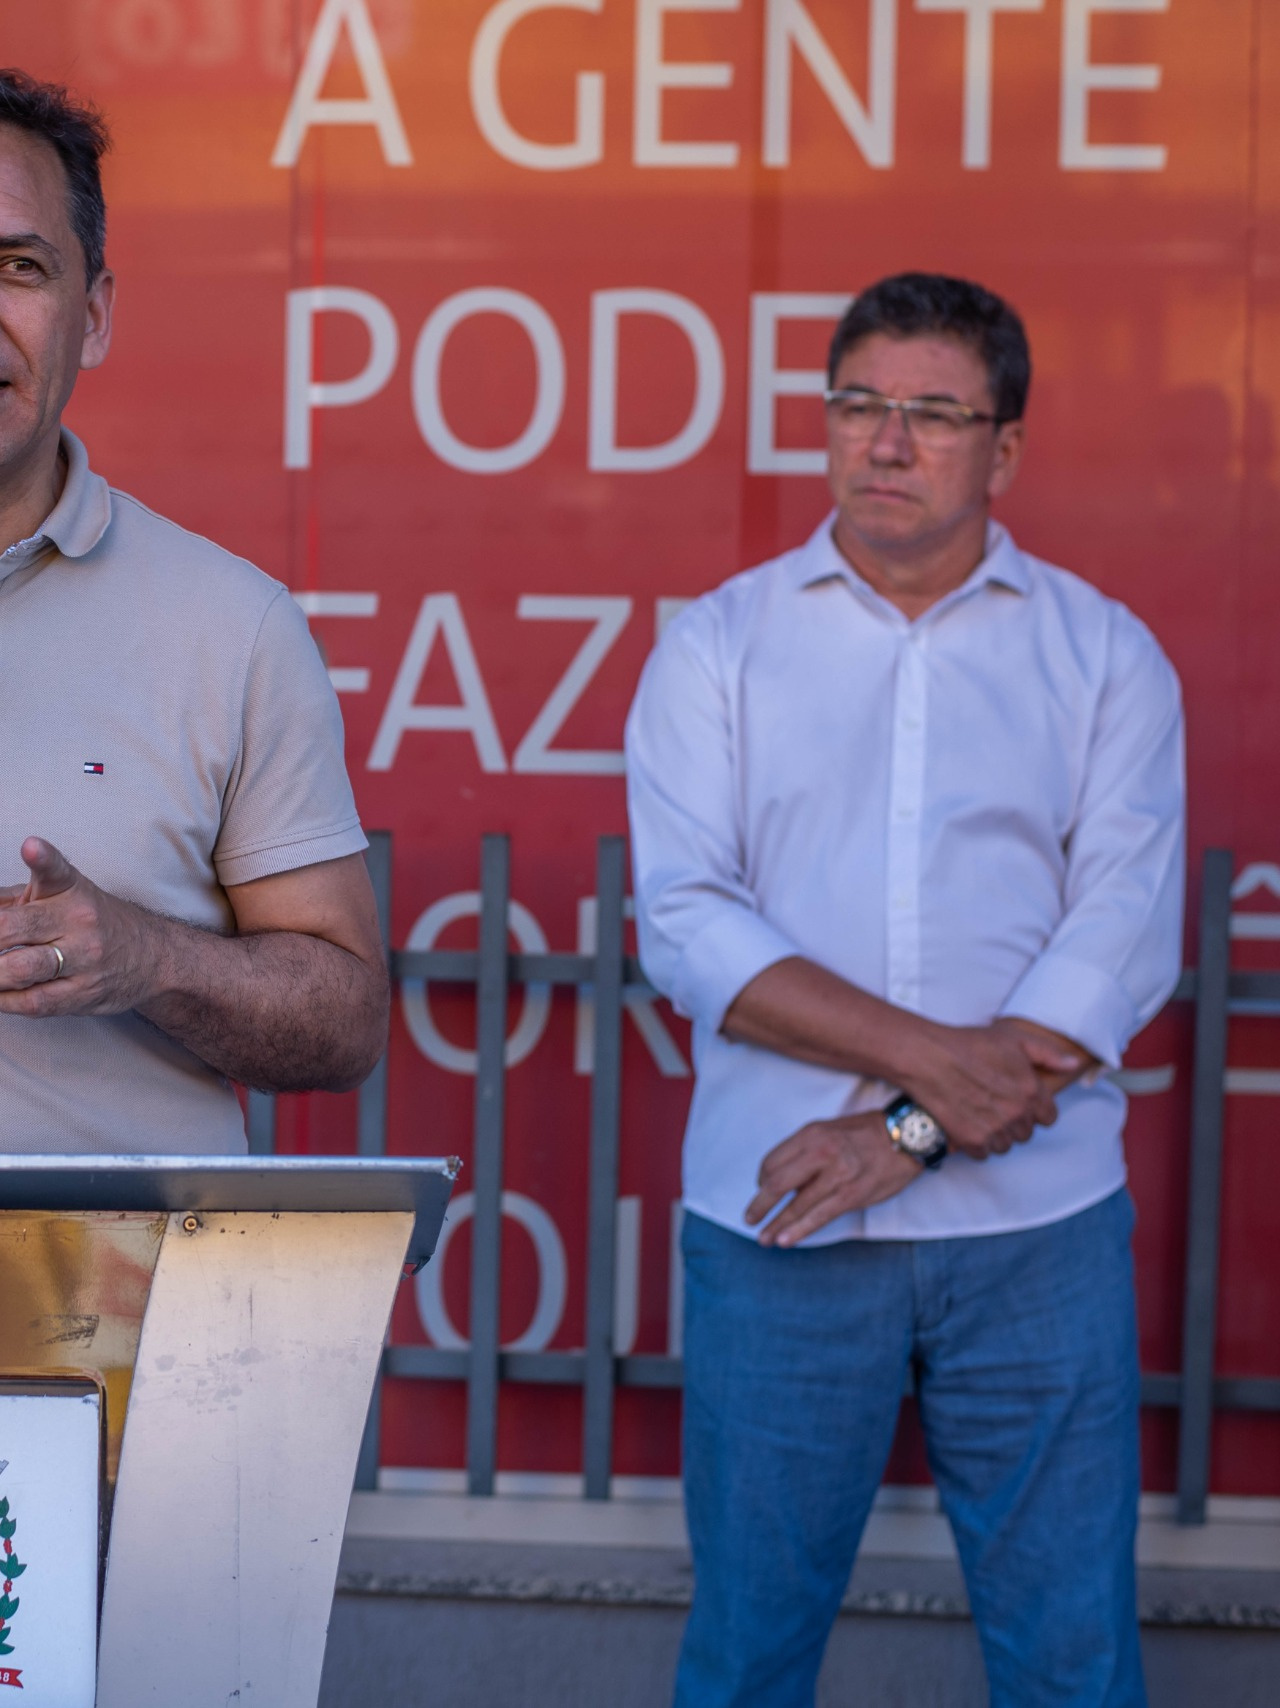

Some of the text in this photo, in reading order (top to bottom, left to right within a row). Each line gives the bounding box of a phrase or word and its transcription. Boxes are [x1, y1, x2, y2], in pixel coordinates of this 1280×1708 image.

[271, 0, 413, 167] A
[468, 0, 1168, 170] GENTE
[284, 286, 856, 476] PODE
